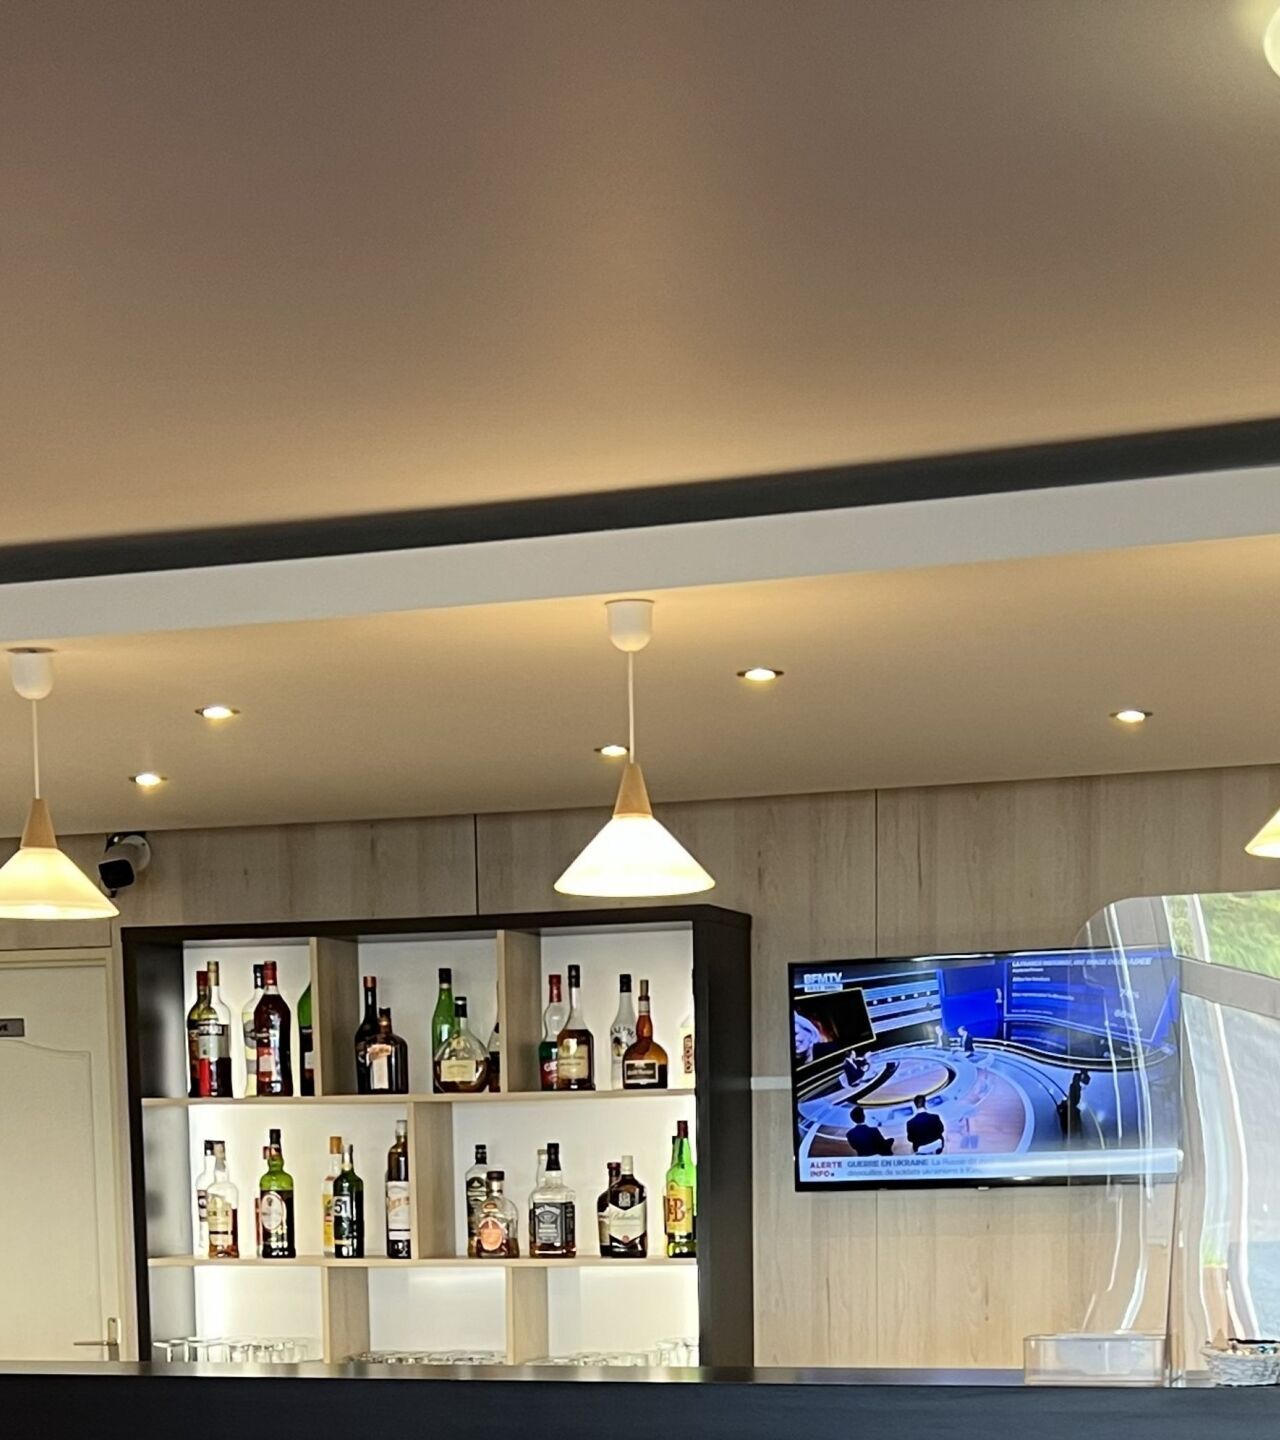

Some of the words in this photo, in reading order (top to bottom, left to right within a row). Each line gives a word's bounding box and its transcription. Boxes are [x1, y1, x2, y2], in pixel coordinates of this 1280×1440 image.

[809, 1160, 842, 1169] ALERTE
[847, 1159, 879, 1168] GUERRE
[880, 1159, 892, 1168] EN
[893, 1158, 928, 1167] UKRAINE
[334, 1199, 348, 1213] 51
